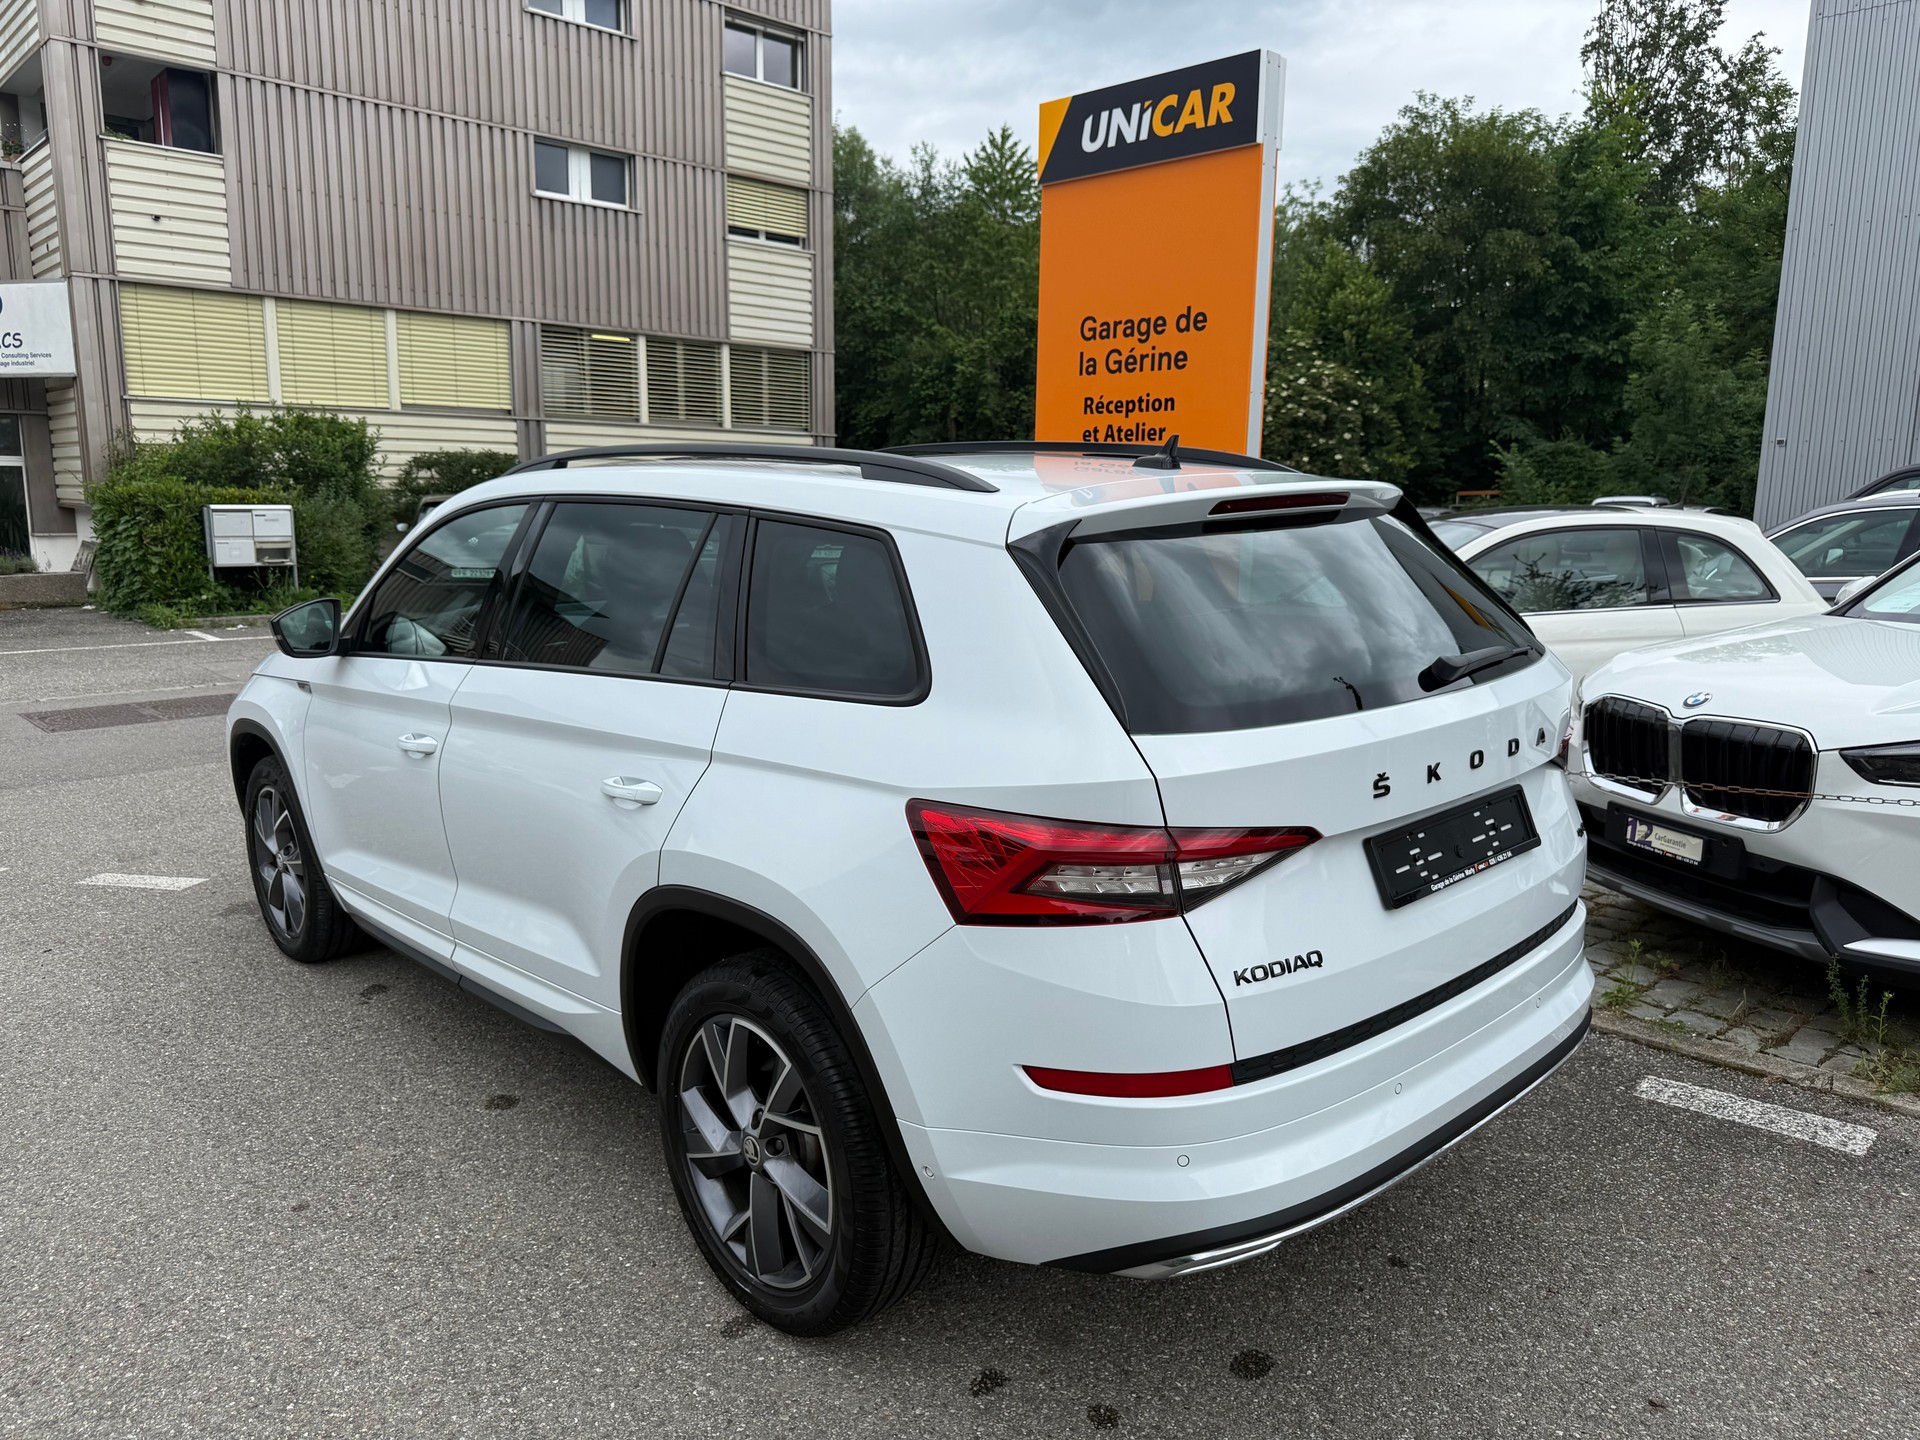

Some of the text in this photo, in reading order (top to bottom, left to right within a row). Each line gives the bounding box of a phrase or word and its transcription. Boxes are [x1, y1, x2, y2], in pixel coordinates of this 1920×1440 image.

[1080, 305, 1208, 344] Garage de
[0, 332, 23, 348] CS
[1079, 346, 1188, 376] la Gérine
[1083, 393, 1175, 418] Réception
[1082, 422, 1166, 442] et Atelier
[1373, 728, 1547, 799] ŠKODA
[1627, 818, 1653, 847] 12
[1654, 832, 1687, 849] CarGarantie
[1431, 881, 1444, 891] Garage
[1233, 949, 1324, 987] KODIAQ
